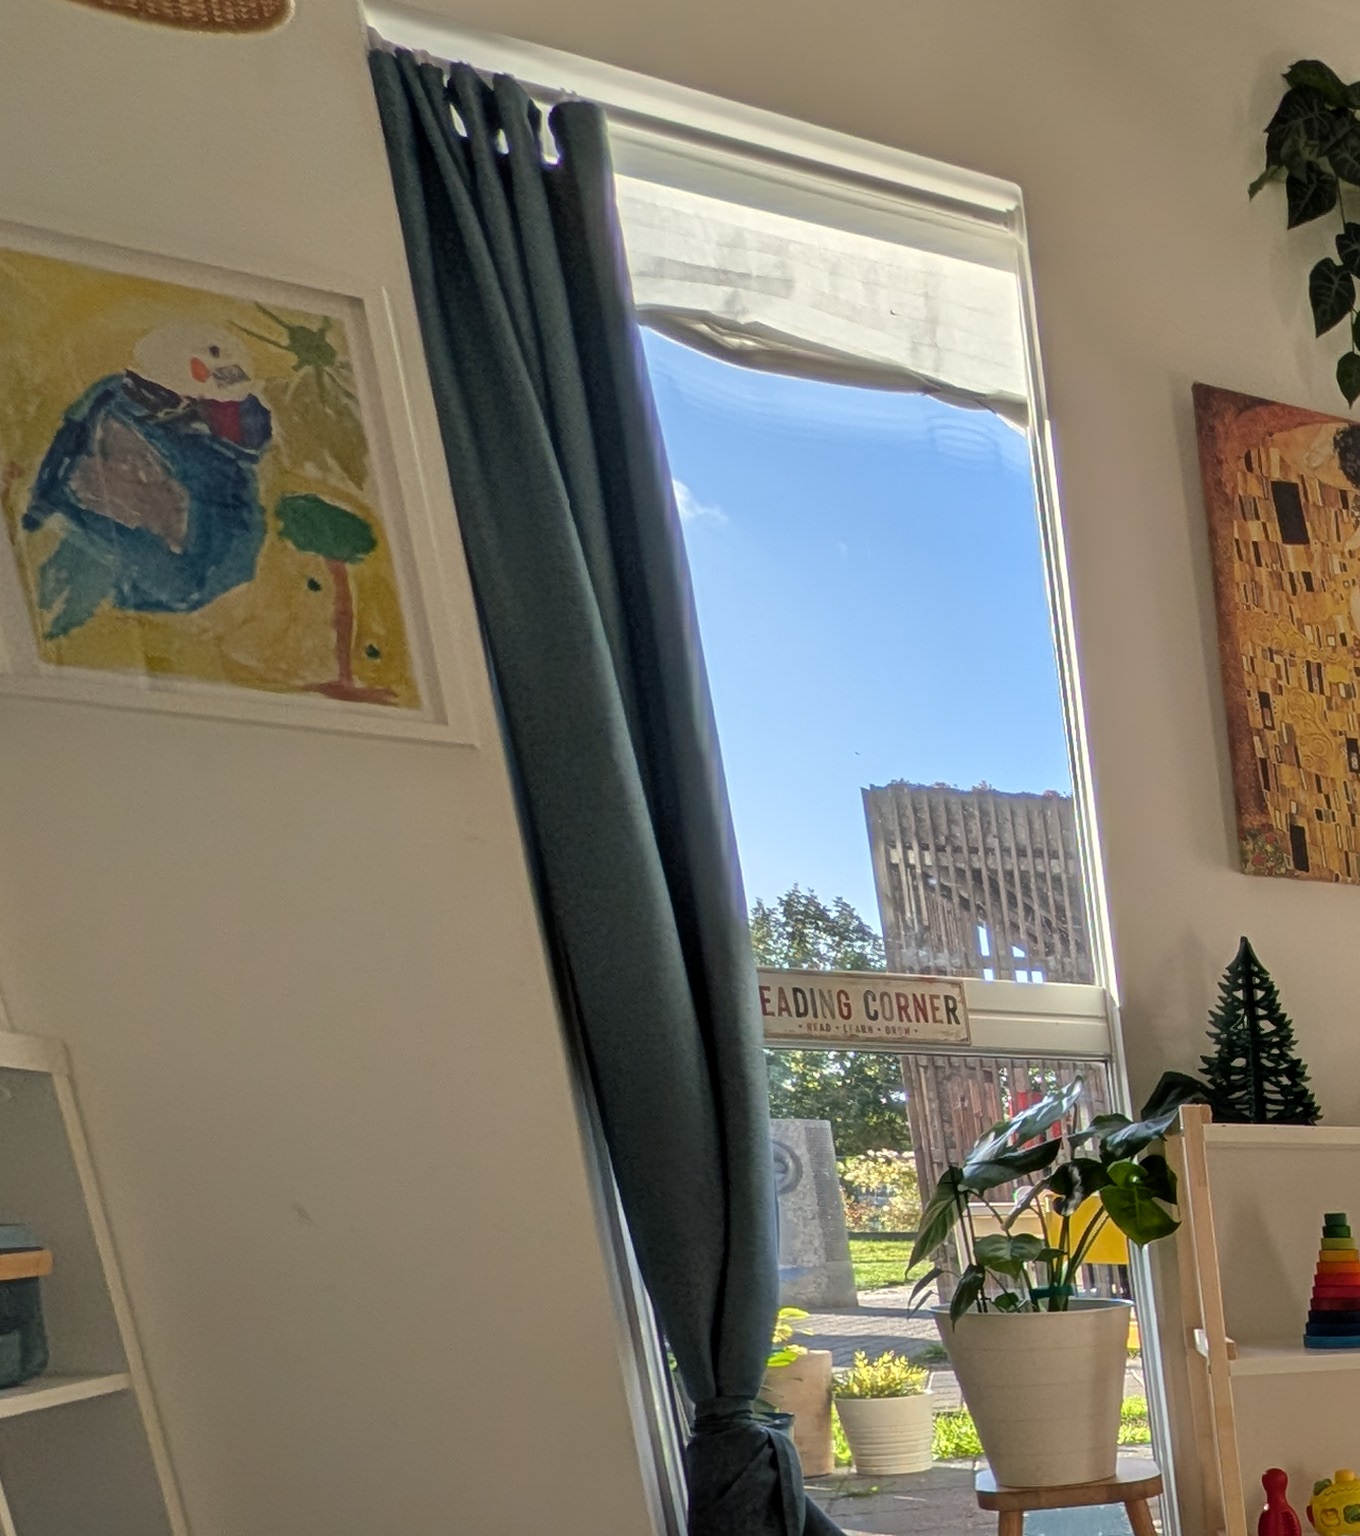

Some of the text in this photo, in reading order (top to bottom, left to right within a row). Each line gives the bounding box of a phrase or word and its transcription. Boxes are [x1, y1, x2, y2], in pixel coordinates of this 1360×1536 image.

[759, 985, 961, 1025] EADING CORNER
[806, 1021, 832, 1032] READ
